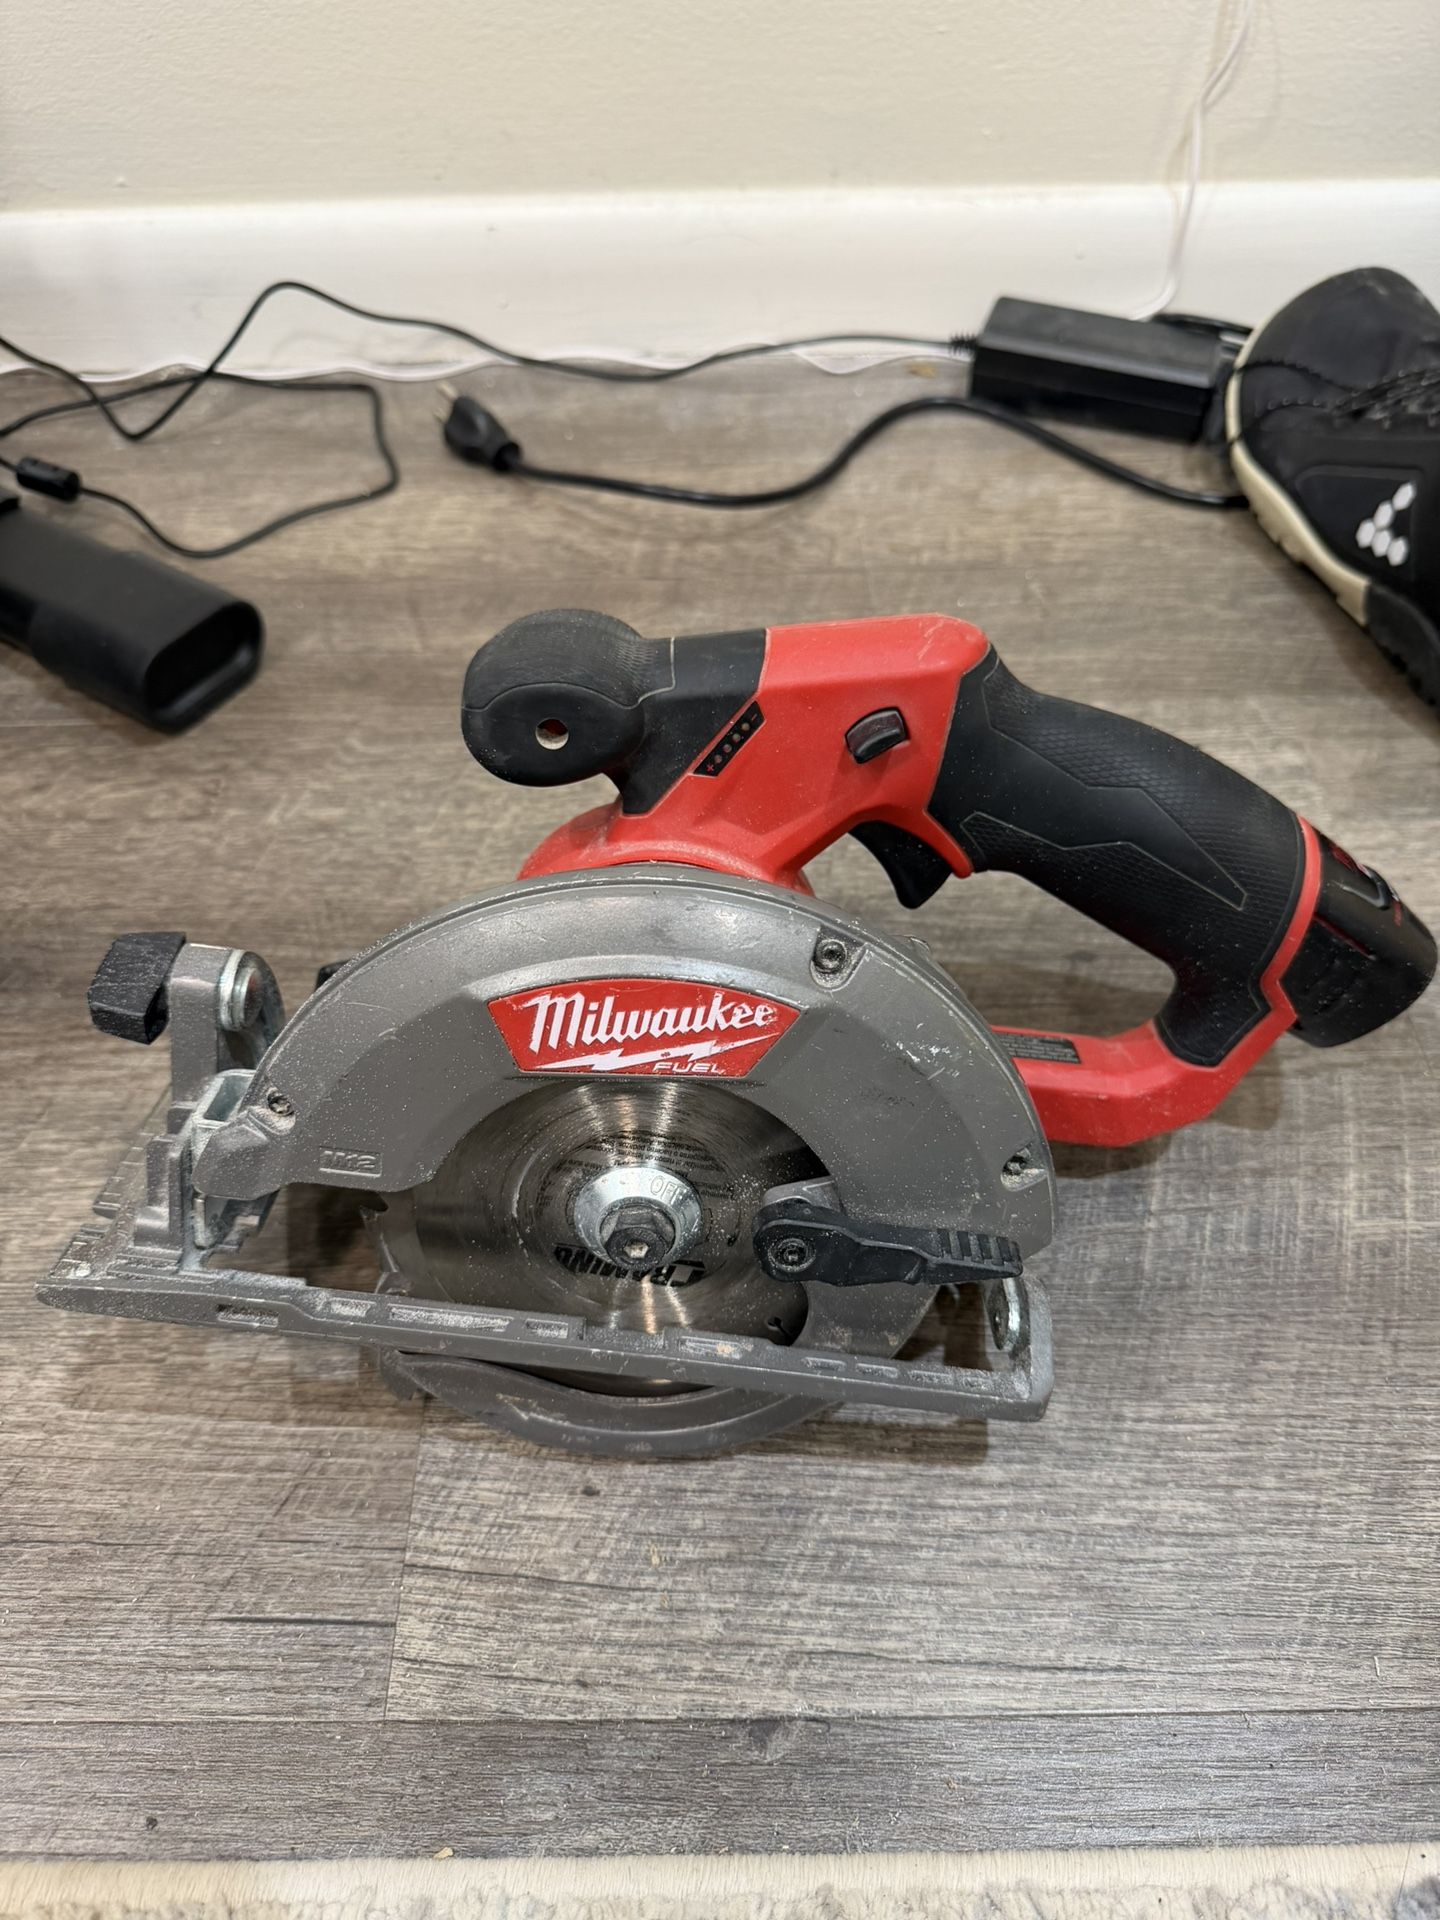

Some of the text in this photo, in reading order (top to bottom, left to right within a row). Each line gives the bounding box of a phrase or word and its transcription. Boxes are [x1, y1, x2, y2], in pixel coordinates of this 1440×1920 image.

[521, 991, 778, 1054] Milwaukee
[652, 1061, 724, 1075] FUEL
[320, 1150, 376, 1170] M12
